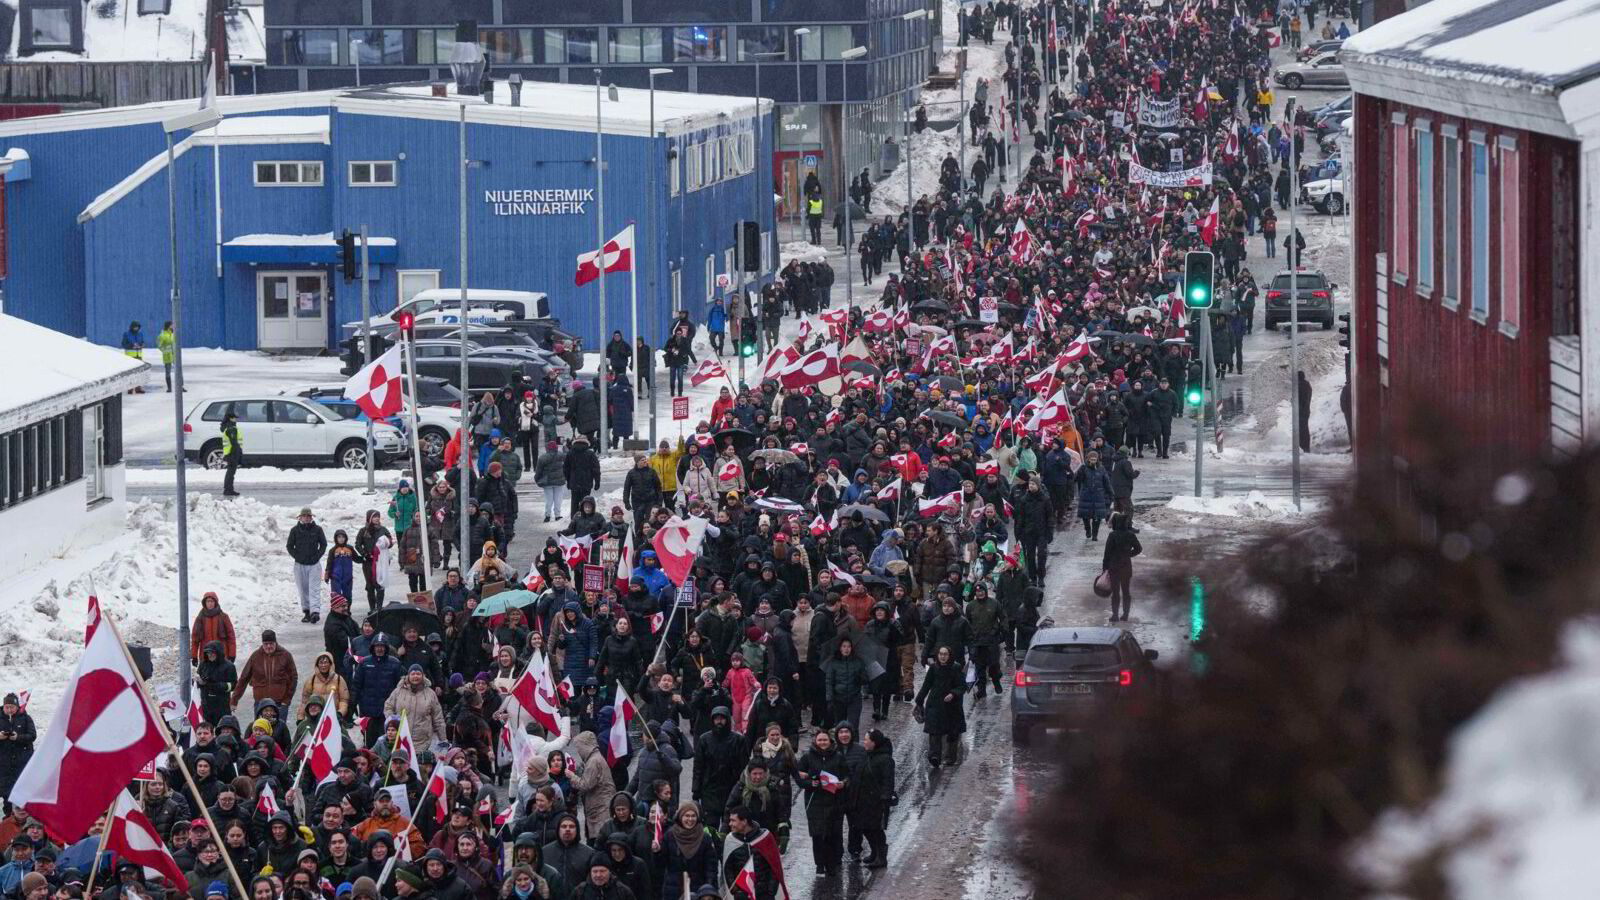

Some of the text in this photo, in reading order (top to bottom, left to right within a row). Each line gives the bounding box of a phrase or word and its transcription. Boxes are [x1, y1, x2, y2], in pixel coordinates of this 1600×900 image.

[1142, 110, 1156, 123] GO
[485, 188, 594, 203] NIUERNERMIK
[495, 202, 585, 216] ILINNIARFIK
